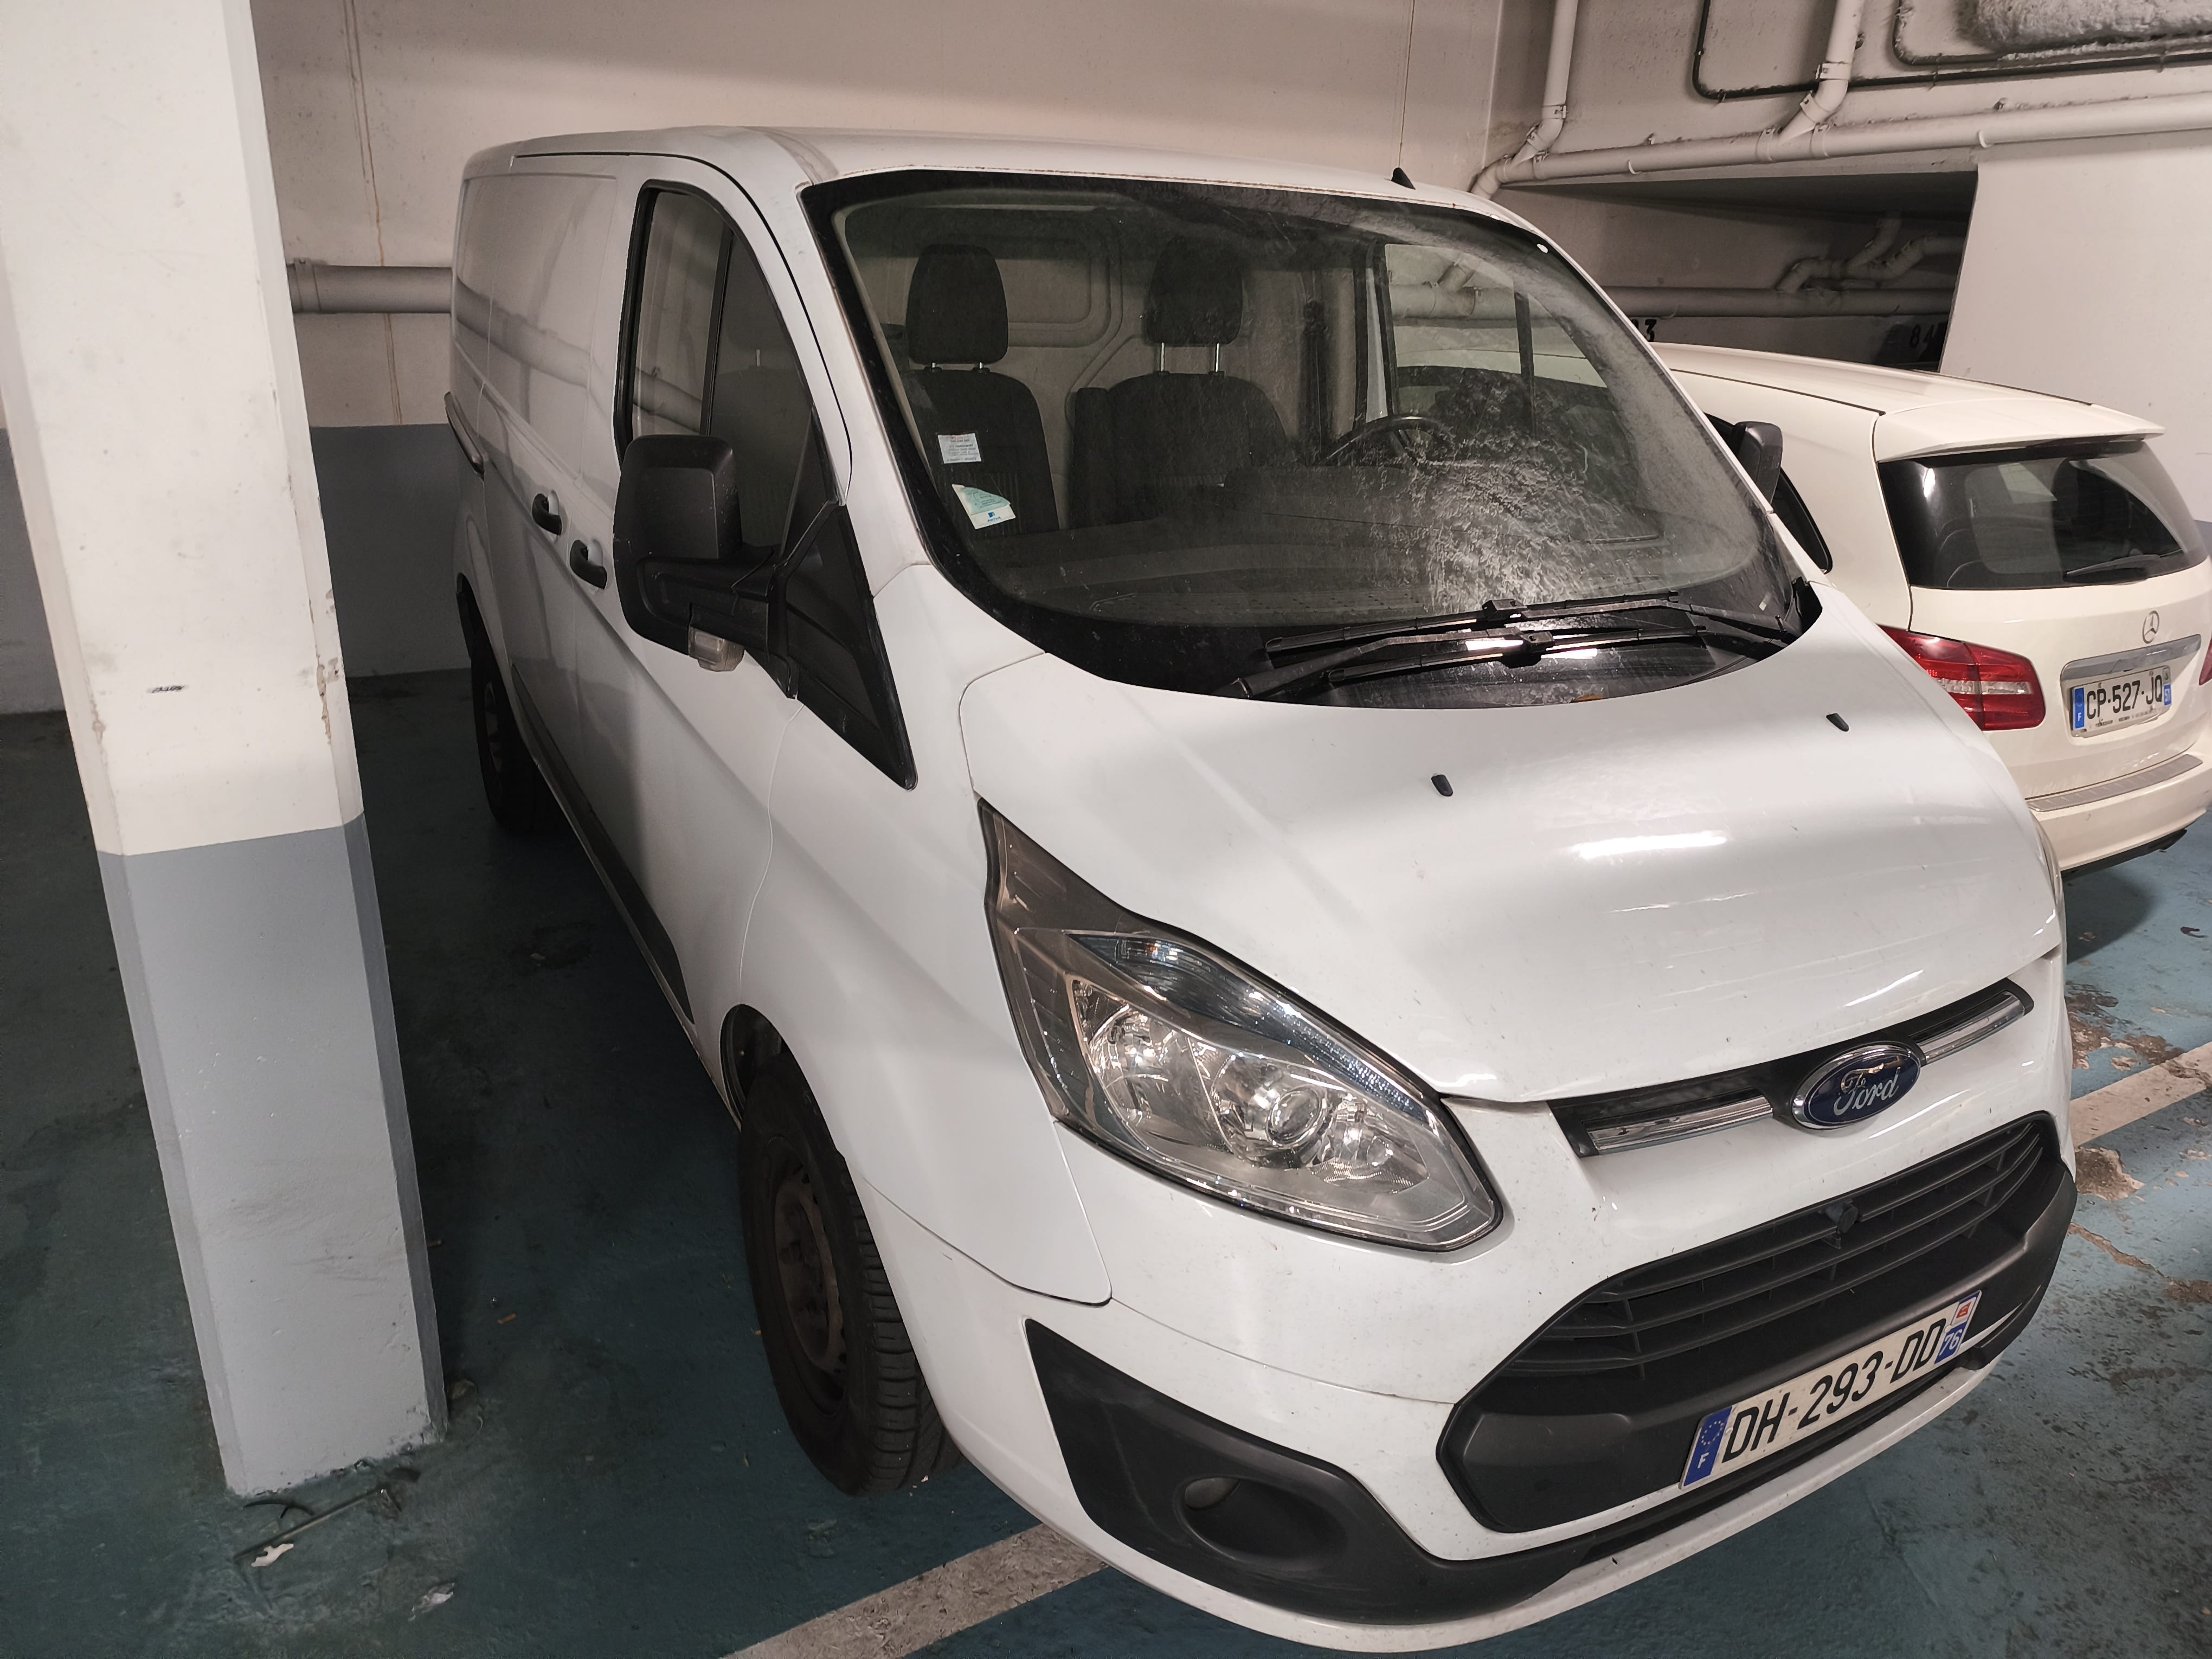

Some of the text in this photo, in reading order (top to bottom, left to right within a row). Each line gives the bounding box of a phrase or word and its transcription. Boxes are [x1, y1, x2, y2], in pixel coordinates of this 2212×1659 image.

[2078, 712, 2082, 722] F
[2087, 674, 2163, 719] CP-527-JQ
[1833, 1063, 1901, 1116] Ford
[1697, 1318, 1963, 1469] F DH-293-DD 76
